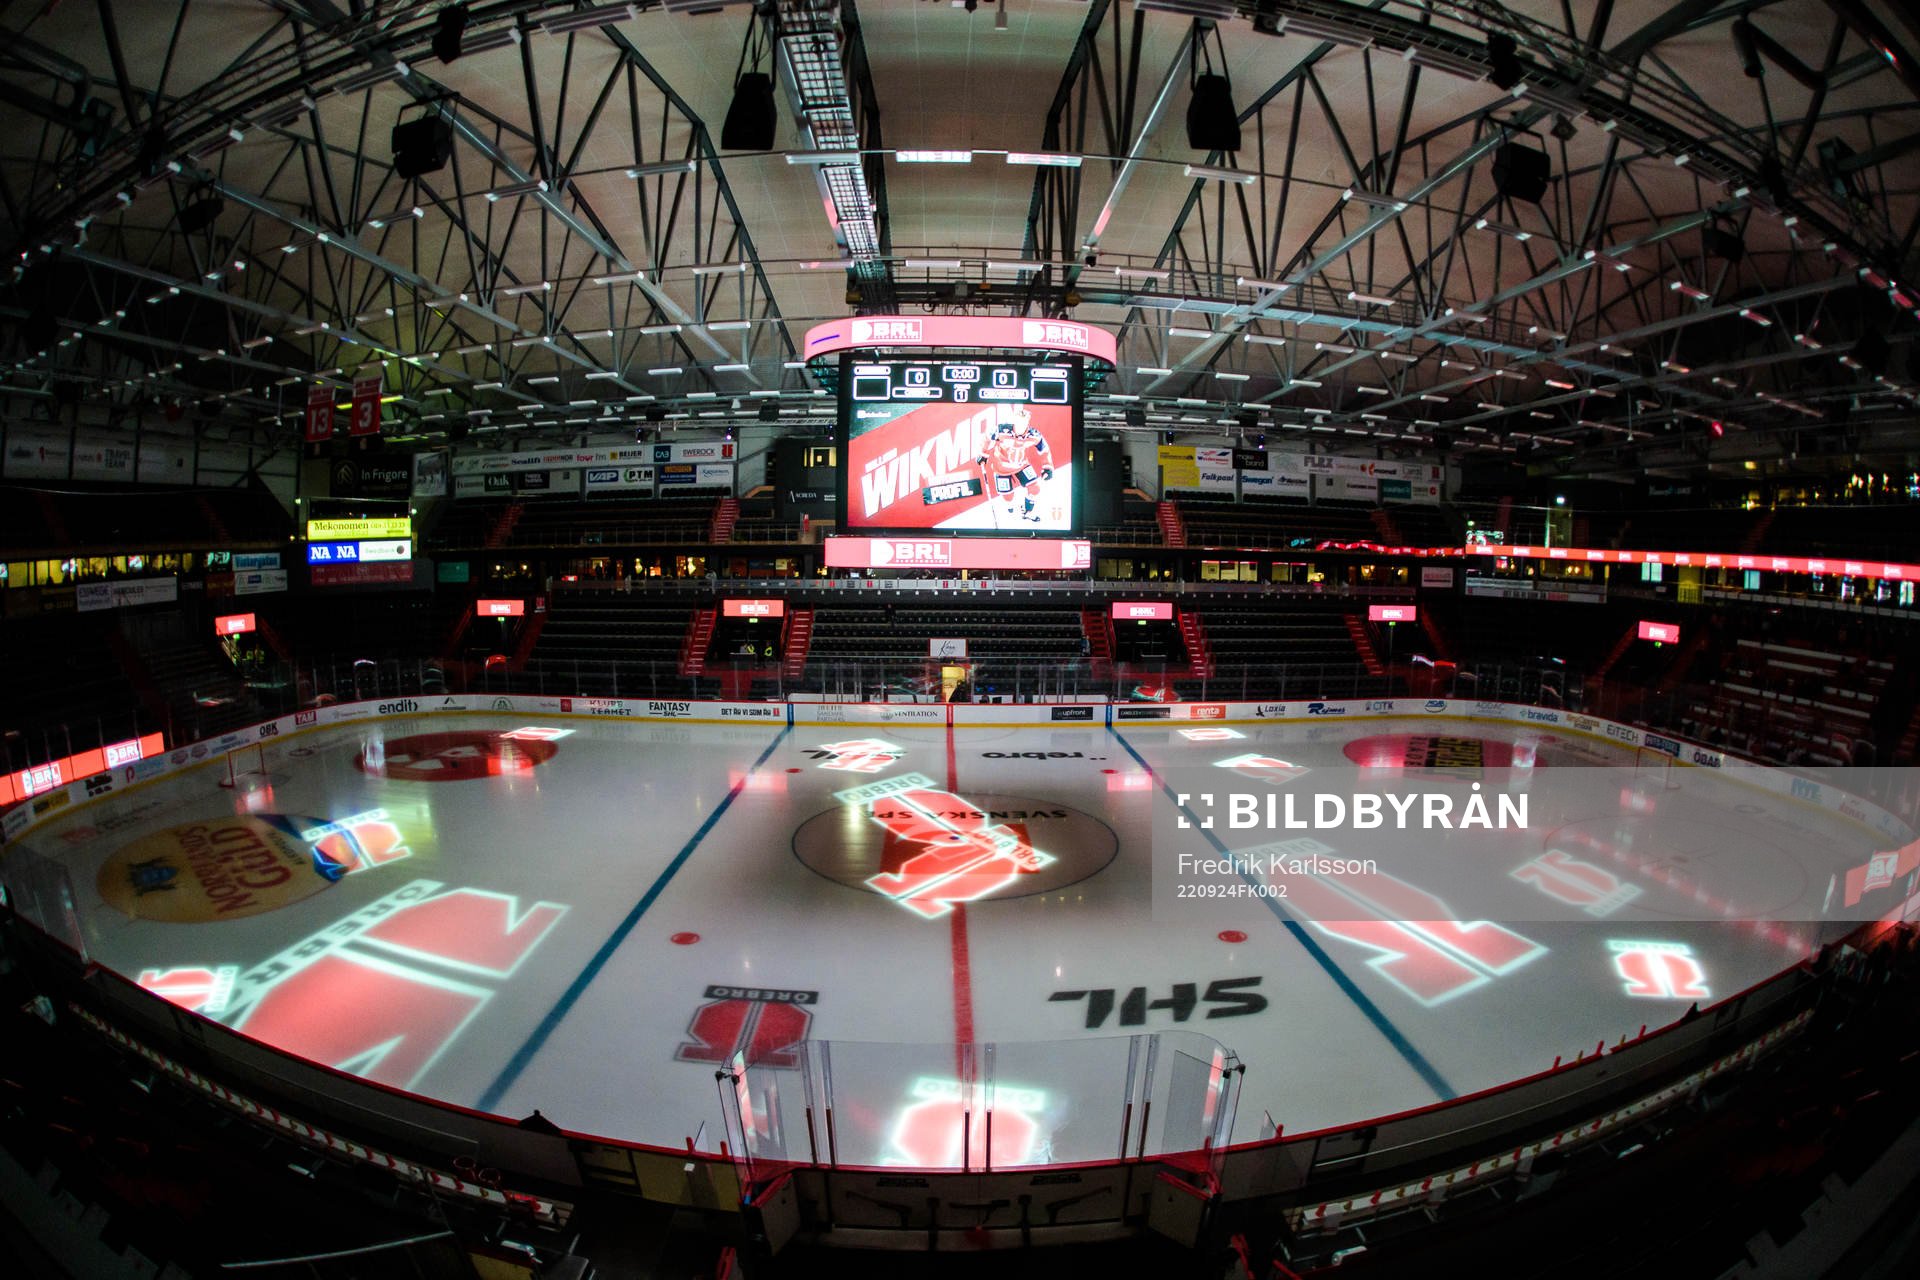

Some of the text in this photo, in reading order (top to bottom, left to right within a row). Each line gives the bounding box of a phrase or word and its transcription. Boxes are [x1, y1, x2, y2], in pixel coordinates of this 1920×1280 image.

[915, 372, 924, 384] 0
[952, 369, 974, 379] 0:00
[999, 373, 1008, 385] 0
[311, 407, 330, 435] 13
[359, 402, 373, 429] 3
[361, 469, 408, 483] In Frigore
[589, 472, 618, 481] VAP
[314, 521, 369, 531] Mekonomen
[311, 545, 357, 560] NA NA
[895, 543, 949, 560] BRL
[379, 700, 413, 715] endit
[649, 702, 690, 711] FANTASY
[721, 708, 732, 716] DET
[749, 708, 762, 716] SOM
[1062, 708, 1086, 717] upfront
[1197, 707, 1220, 715] renta
[894, 710, 938, 718] VENTILATION
[1527, 710, 1558, 723] bravida
[210, 826, 292, 889] GULD
[711, 985, 813, 1002] ÖREBRO
[1049, 976, 1269, 1030] SHL
